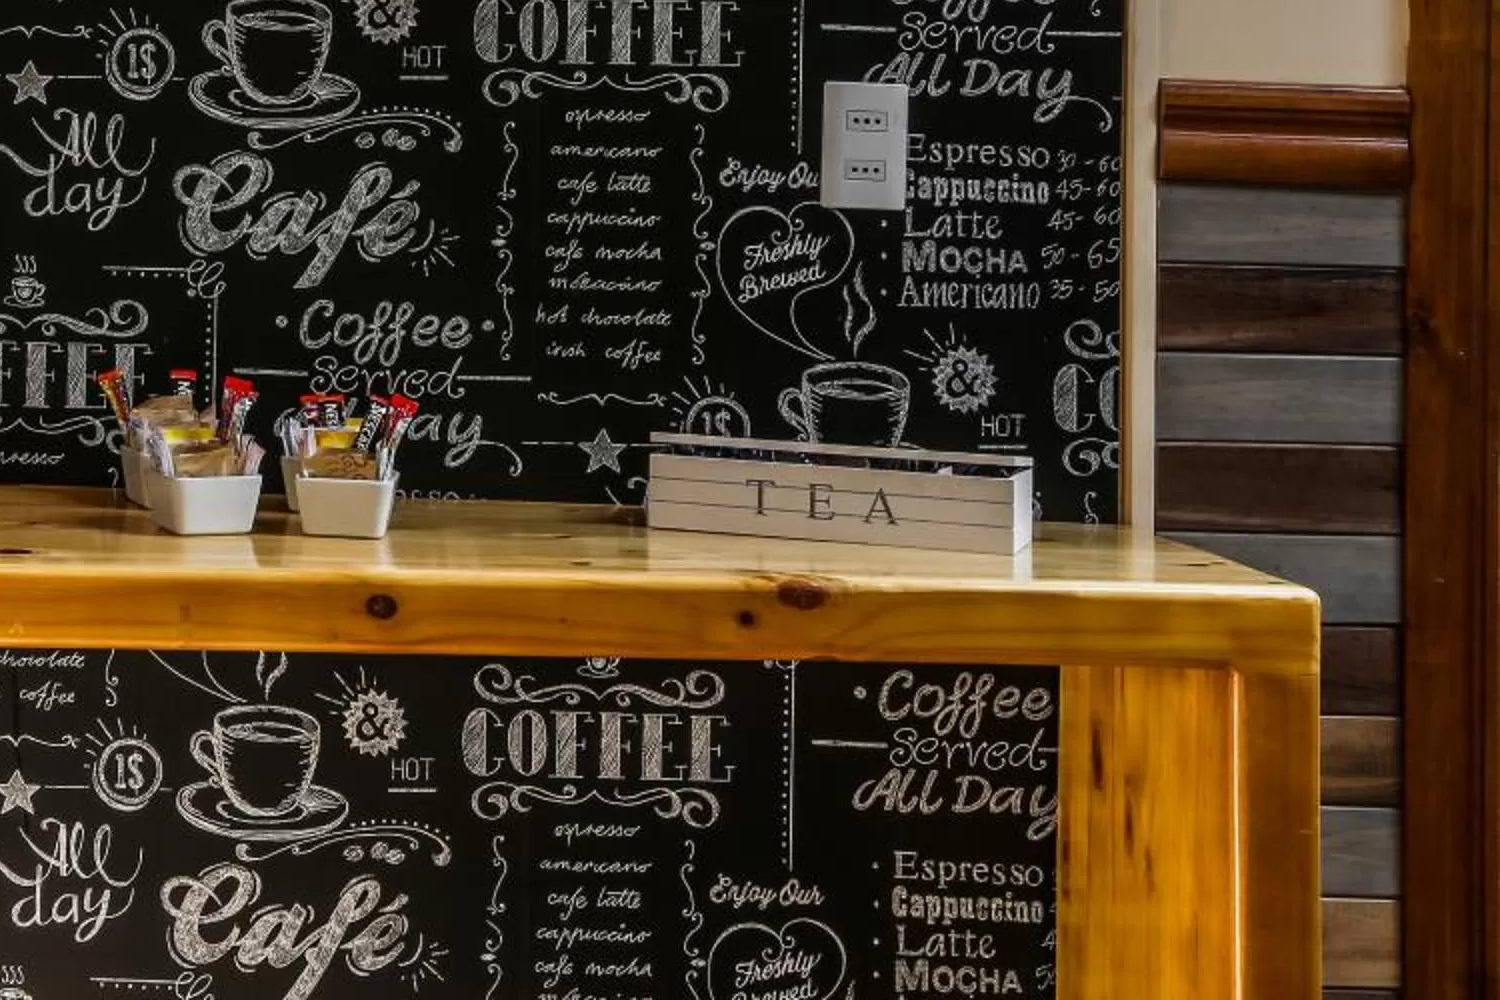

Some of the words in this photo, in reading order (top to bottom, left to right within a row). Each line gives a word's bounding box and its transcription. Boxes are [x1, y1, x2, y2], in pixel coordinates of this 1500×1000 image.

[898, 12, 1056, 55] Served
[24, 157, 147, 232] day
[172, 150, 422, 289] Café
[738, 261, 827, 304] Brewed
[299, 299, 474, 366] Coffee
[980, 413, 1026, 438] HOT
[745, 478, 901, 526] TEA
[461, 706, 736, 784] COFFEE
[709, 872, 778, 910] Enjoy
[778, 880, 825, 906] Our
[892, 851, 1045, 891] Espresso
